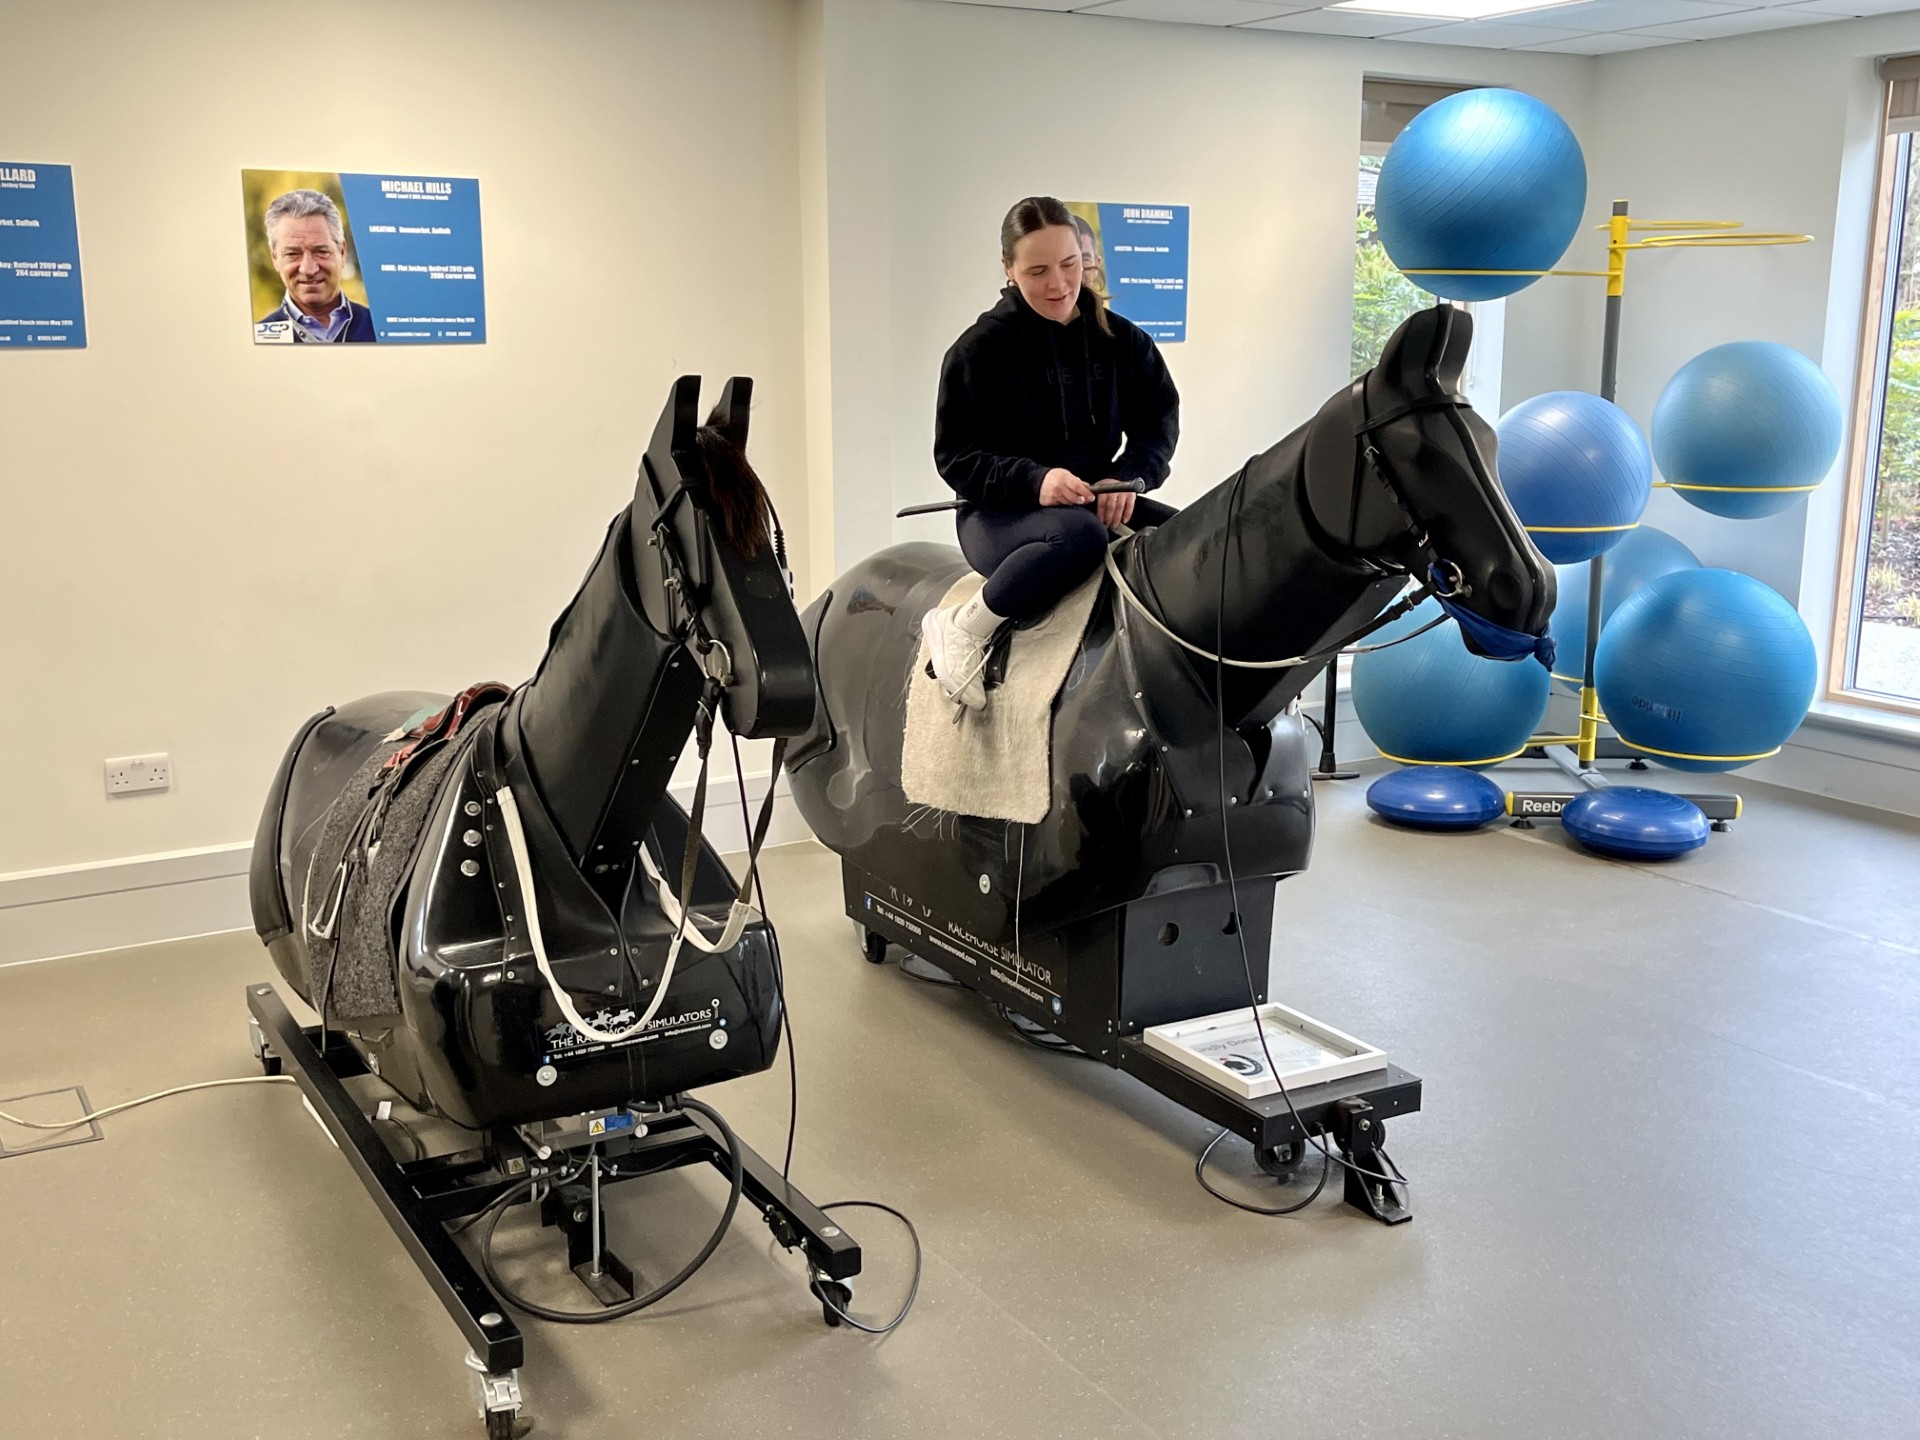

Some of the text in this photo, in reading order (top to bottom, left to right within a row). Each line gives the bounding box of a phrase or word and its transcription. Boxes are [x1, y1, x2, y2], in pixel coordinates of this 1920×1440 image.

[381, 180, 452, 195] MICHAEL HILLS
[1123, 208, 1140, 219] JOHN
[13, 261, 39, 270] Retired
[30, 270, 52, 278] career
[1522, 799, 1567, 813] Reeb
[1000, 945, 1052, 986] SIMULATOR
[550, 1034, 574, 1050] THE
[647, 1008, 712, 1031] SIMULATORS
